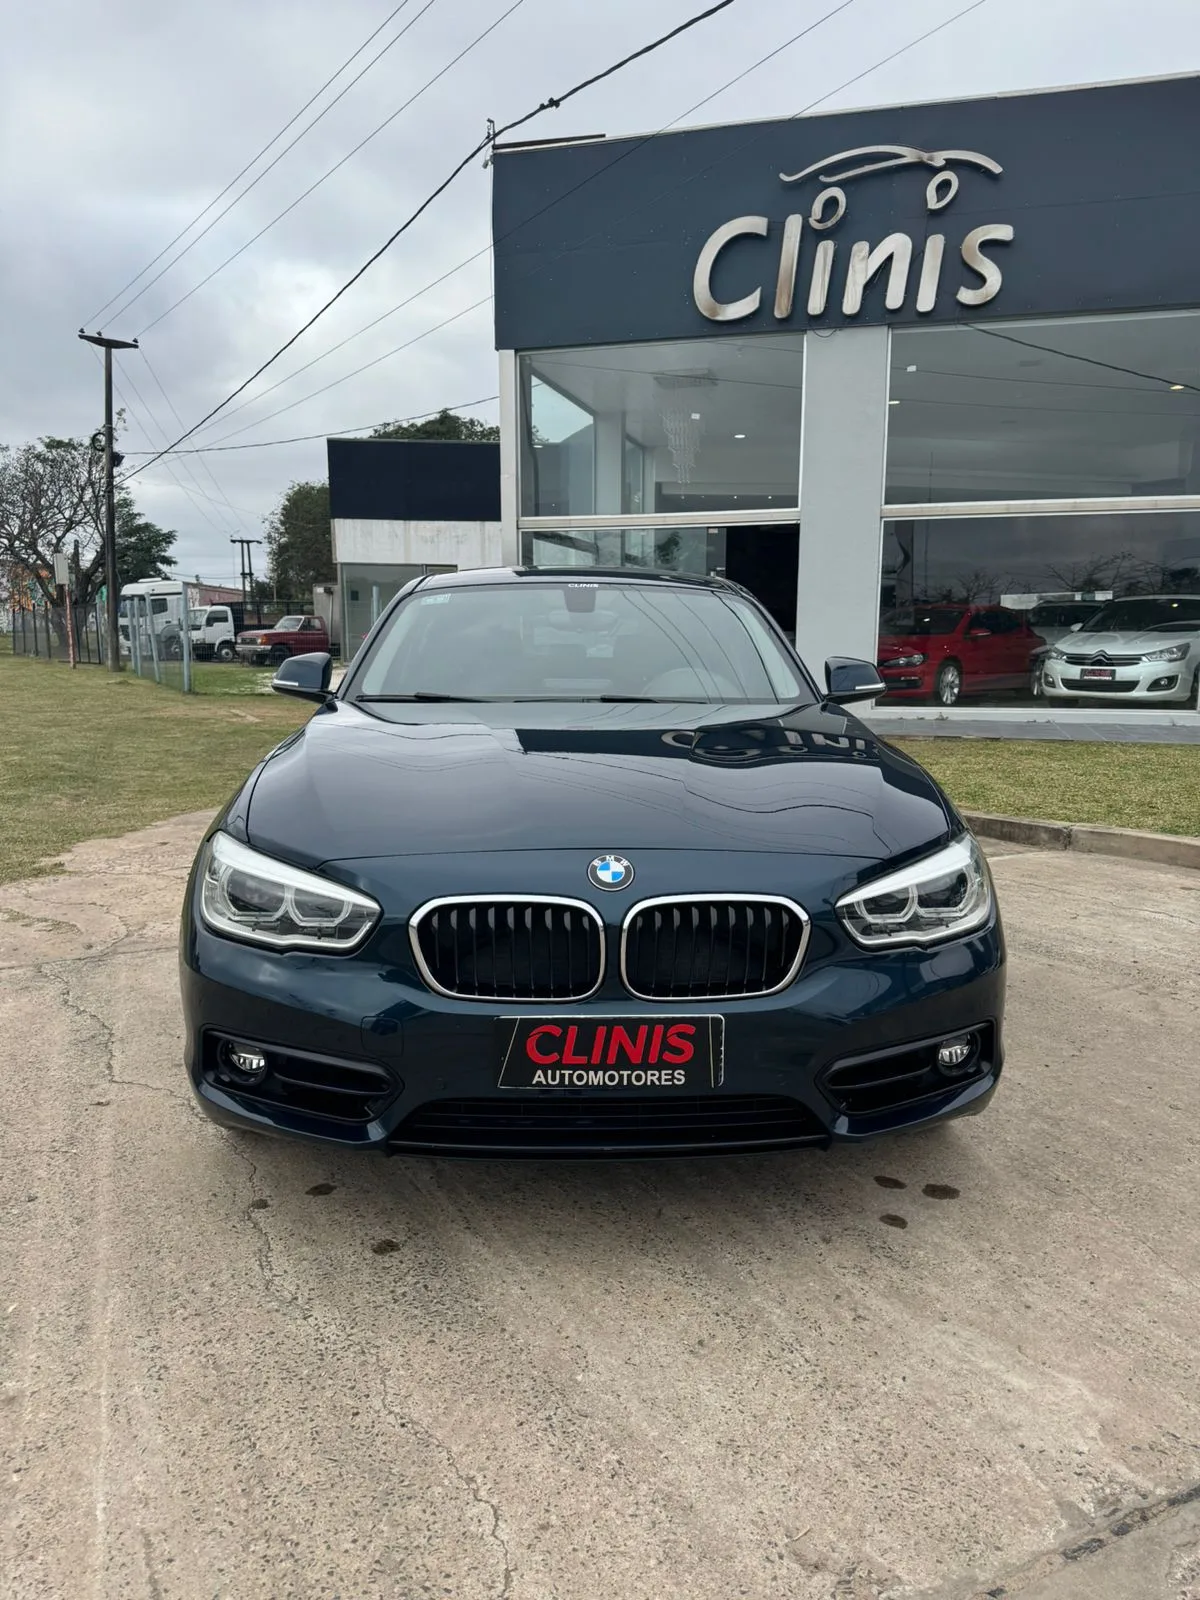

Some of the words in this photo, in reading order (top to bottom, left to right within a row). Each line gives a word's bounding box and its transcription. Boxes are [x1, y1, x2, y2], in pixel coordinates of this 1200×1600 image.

[693, 170, 1014, 321] Clinis
[592, 855, 630, 867] BMW
[526, 1024, 696, 1065] CLINIS
[532, 1069, 685, 1086] AUTOMOTORES
